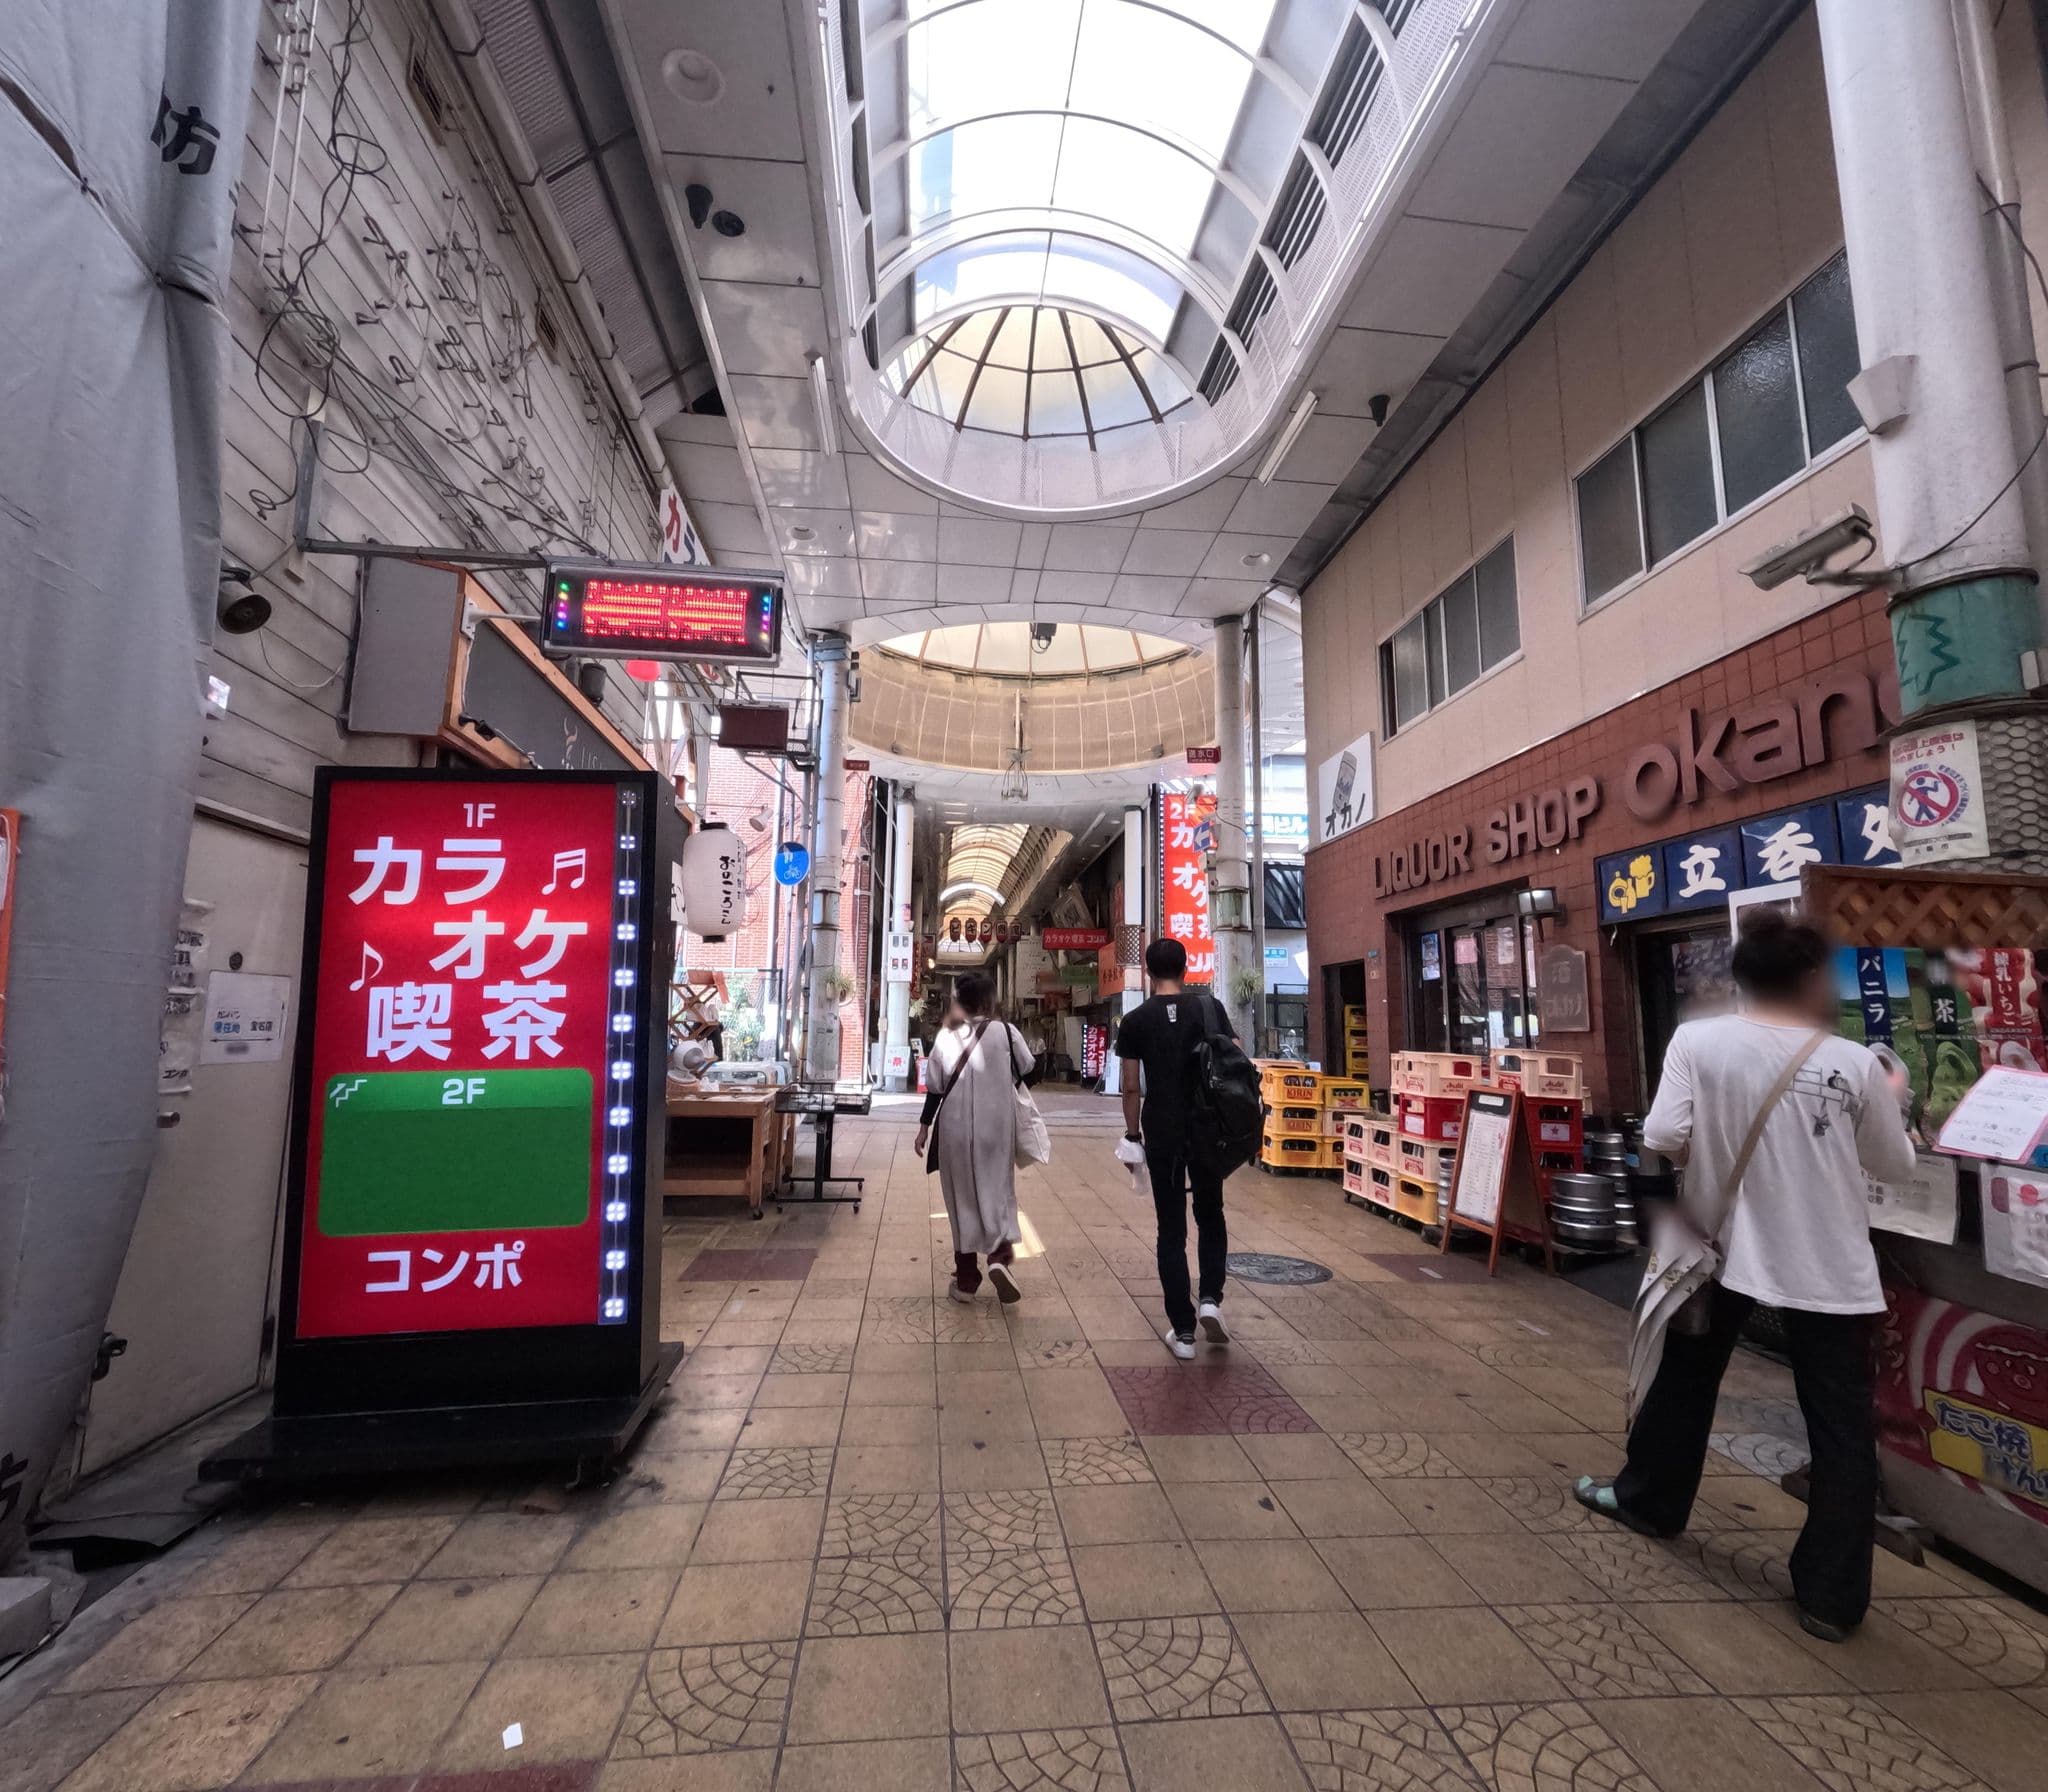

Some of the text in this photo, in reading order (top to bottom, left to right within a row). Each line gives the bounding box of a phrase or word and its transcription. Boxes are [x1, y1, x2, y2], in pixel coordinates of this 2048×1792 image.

[463, 803, 496, 828] 1F
[1325, 792, 1367, 837] オカノ
[1373, 775, 1600, 899] LIQUOR SHOP
[349, 836, 505, 907] カラ
[429, 908, 589, 979] オケ
[366, 980, 567, 1062] 喫茶
[1860, 955, 1886, 1024] バニラ
[441, 1078, 486, 1105] 2F
[365, 1240, 526, 1293] コンポ
[1935, 1399, 2032, 1459] たこ焼
